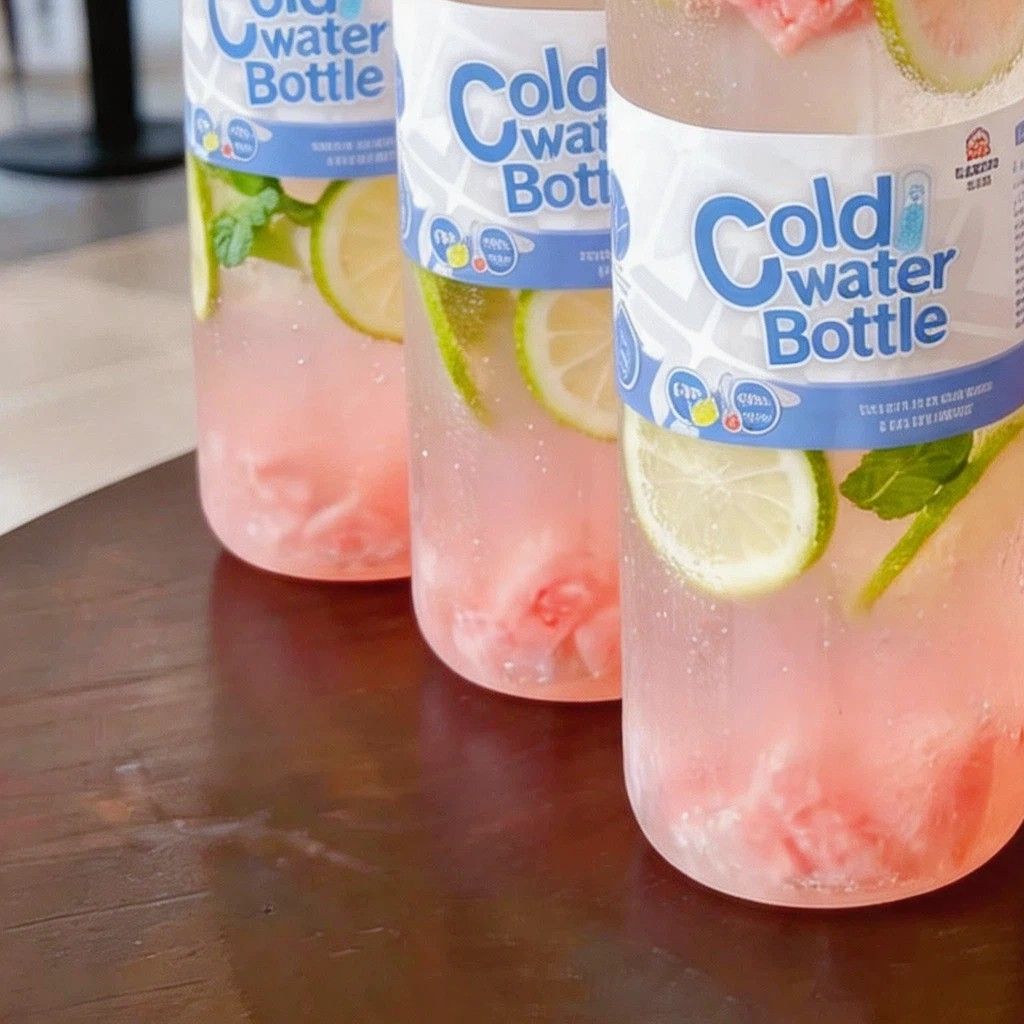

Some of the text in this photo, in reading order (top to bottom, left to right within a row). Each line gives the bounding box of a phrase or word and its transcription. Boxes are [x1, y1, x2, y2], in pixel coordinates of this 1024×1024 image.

[260, 17, 388, 59] water
[246, 58, 384, 105] Bottle
[449, 46, 607, 163] Cold
[522, 113, 607, 161] wat
[502, 159, 611, 214] Bott
[694, 174, 893, 308] Cold
[787, 248, 956, 306] water
[763, 298, 949, 366] Bottle
